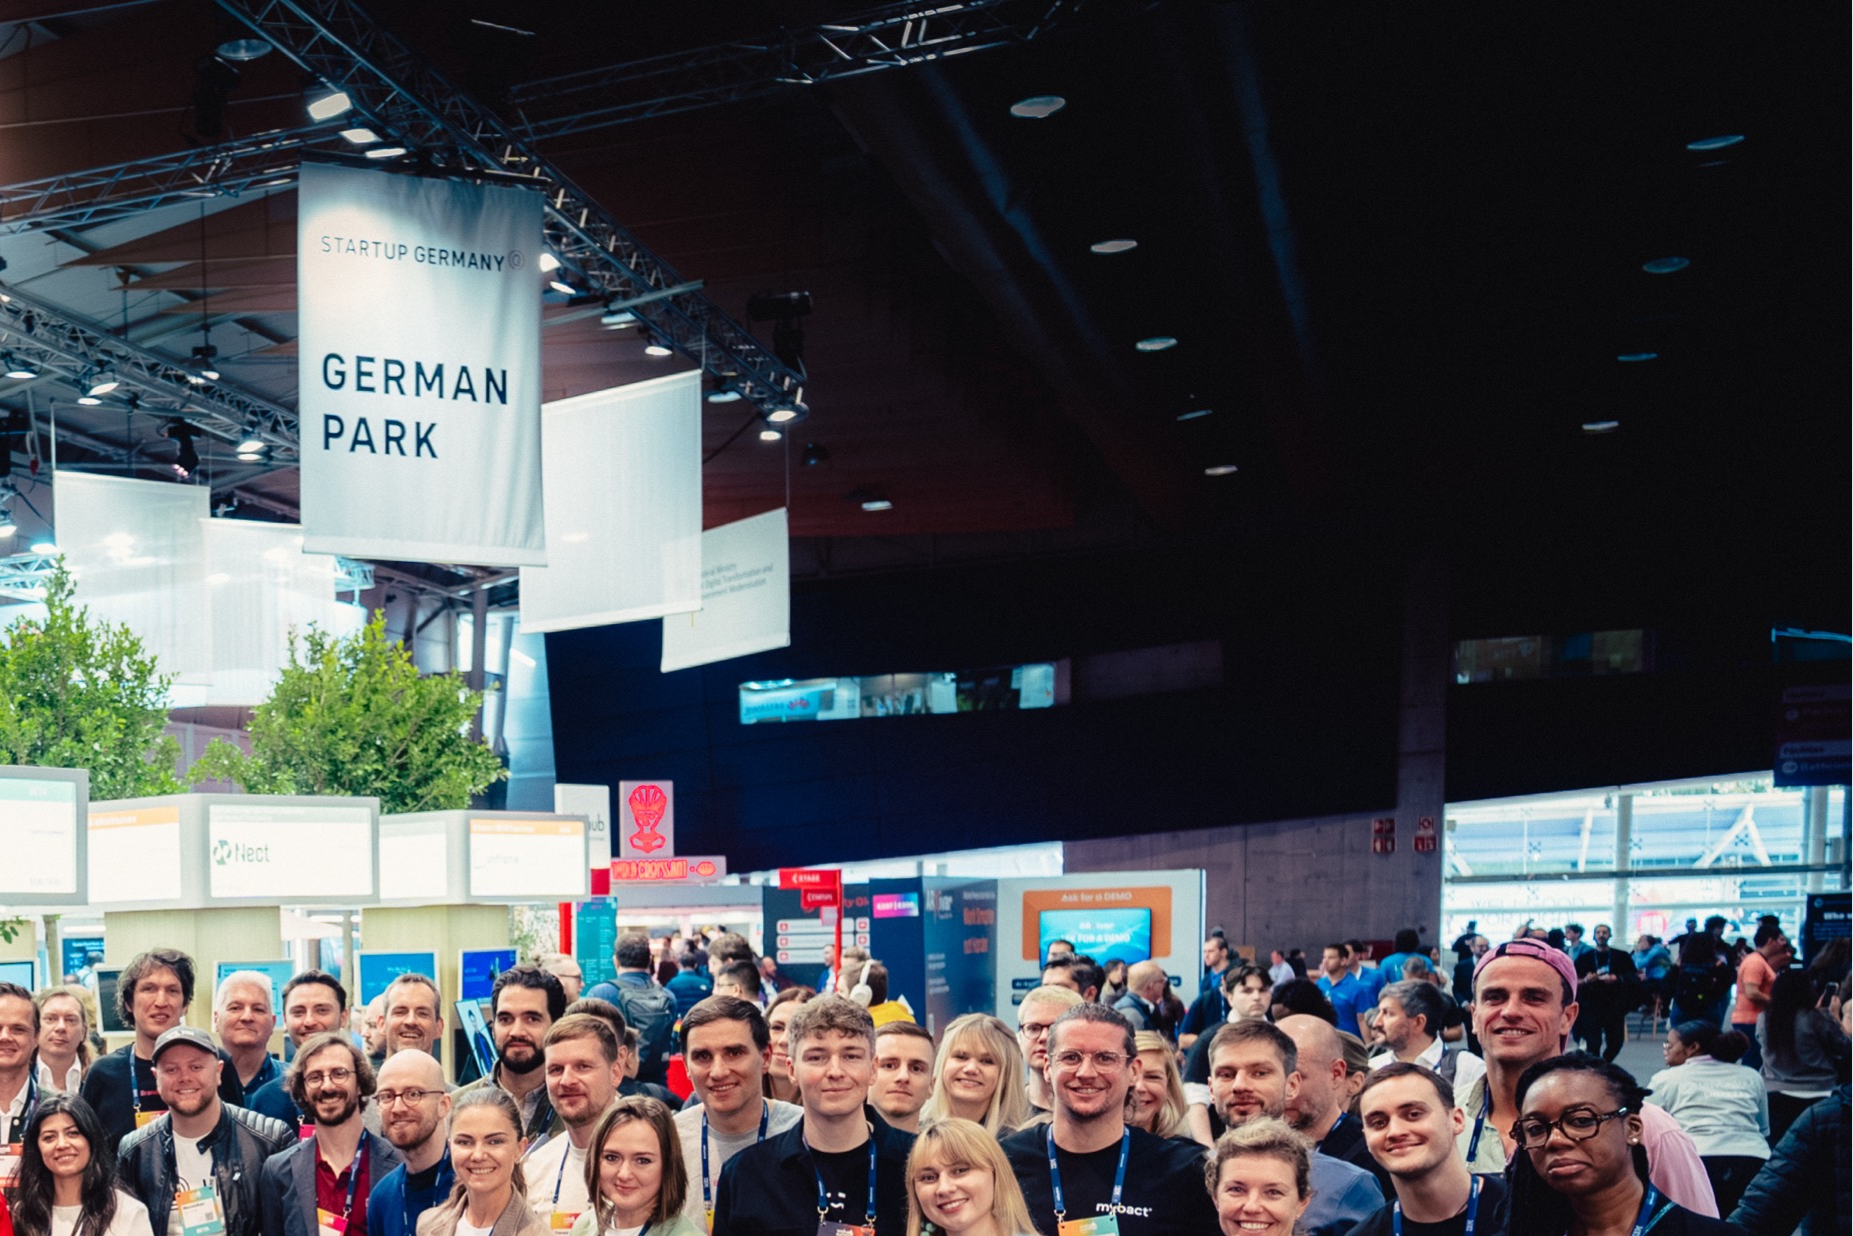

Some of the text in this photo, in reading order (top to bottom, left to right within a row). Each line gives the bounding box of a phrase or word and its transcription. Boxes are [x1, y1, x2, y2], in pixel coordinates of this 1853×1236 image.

[321, 235, 506, 272] STARTUP GERMANY
[322, 352, 508, 405] GERMAN
[322, 413, 439, 459] PARK
[234, 842, 271, 863] Nect
